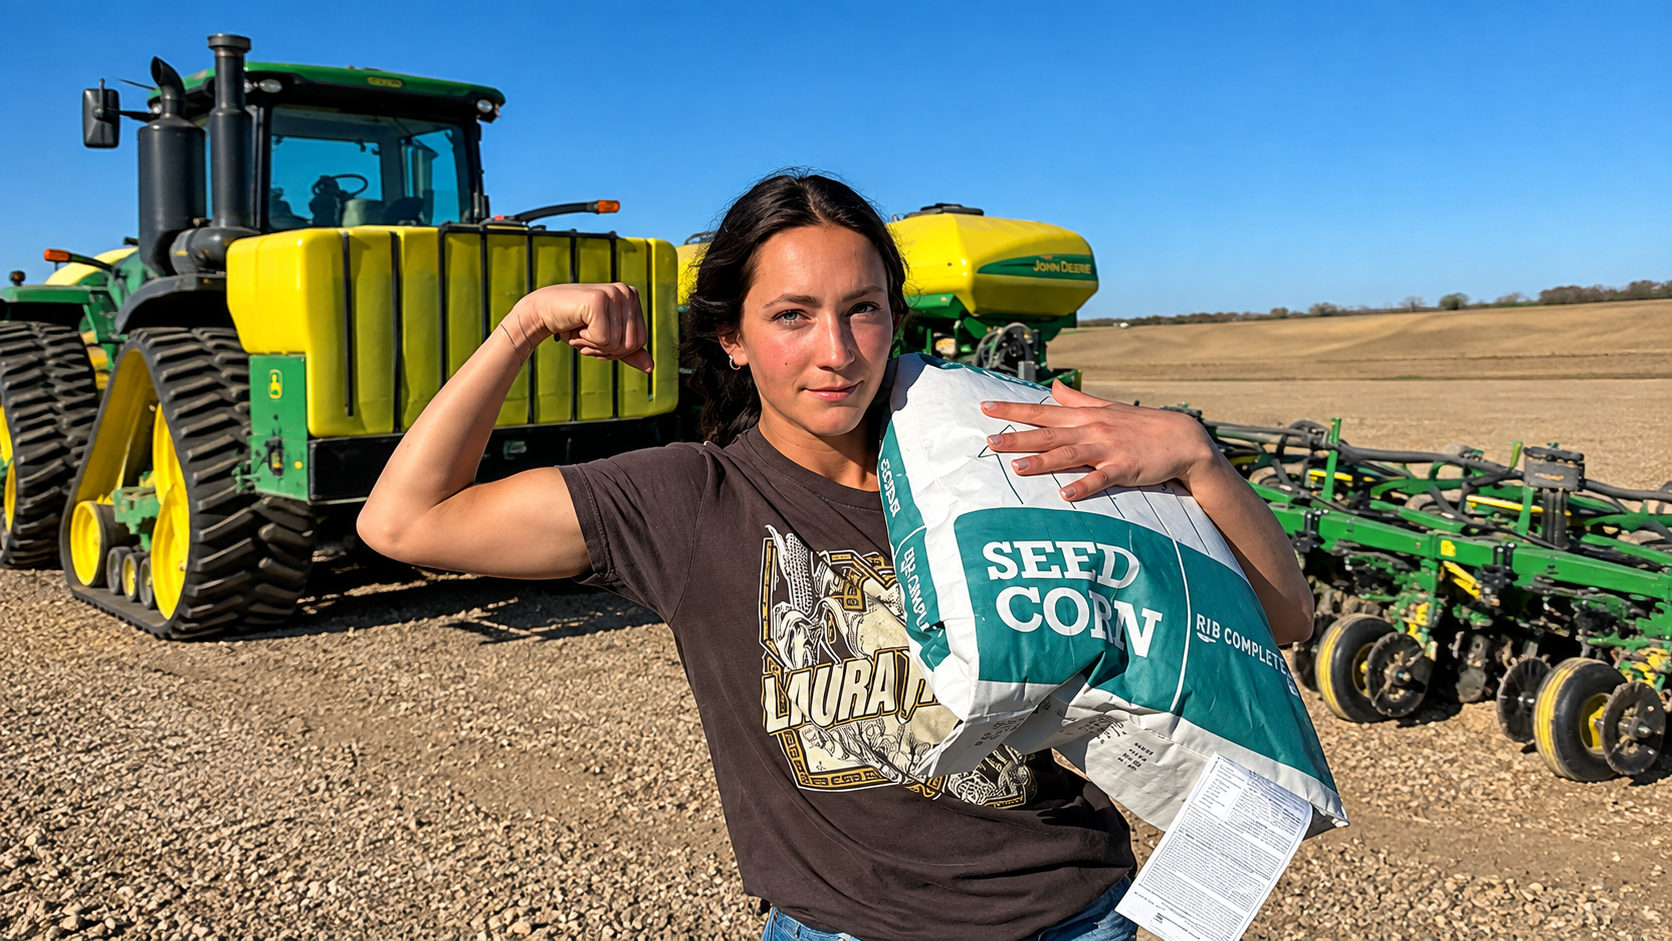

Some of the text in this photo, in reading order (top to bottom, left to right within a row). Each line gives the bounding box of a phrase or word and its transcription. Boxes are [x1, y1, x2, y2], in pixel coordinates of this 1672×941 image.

[1060, 260, 1092, 274] DEERE
[982, 540, 1140, 589] SEED
[996, 586, 1163, 658] CORN
[1196, 613, 1287, 675] RIB COMPLETE
[763, 650, 897, 733] LAURA
